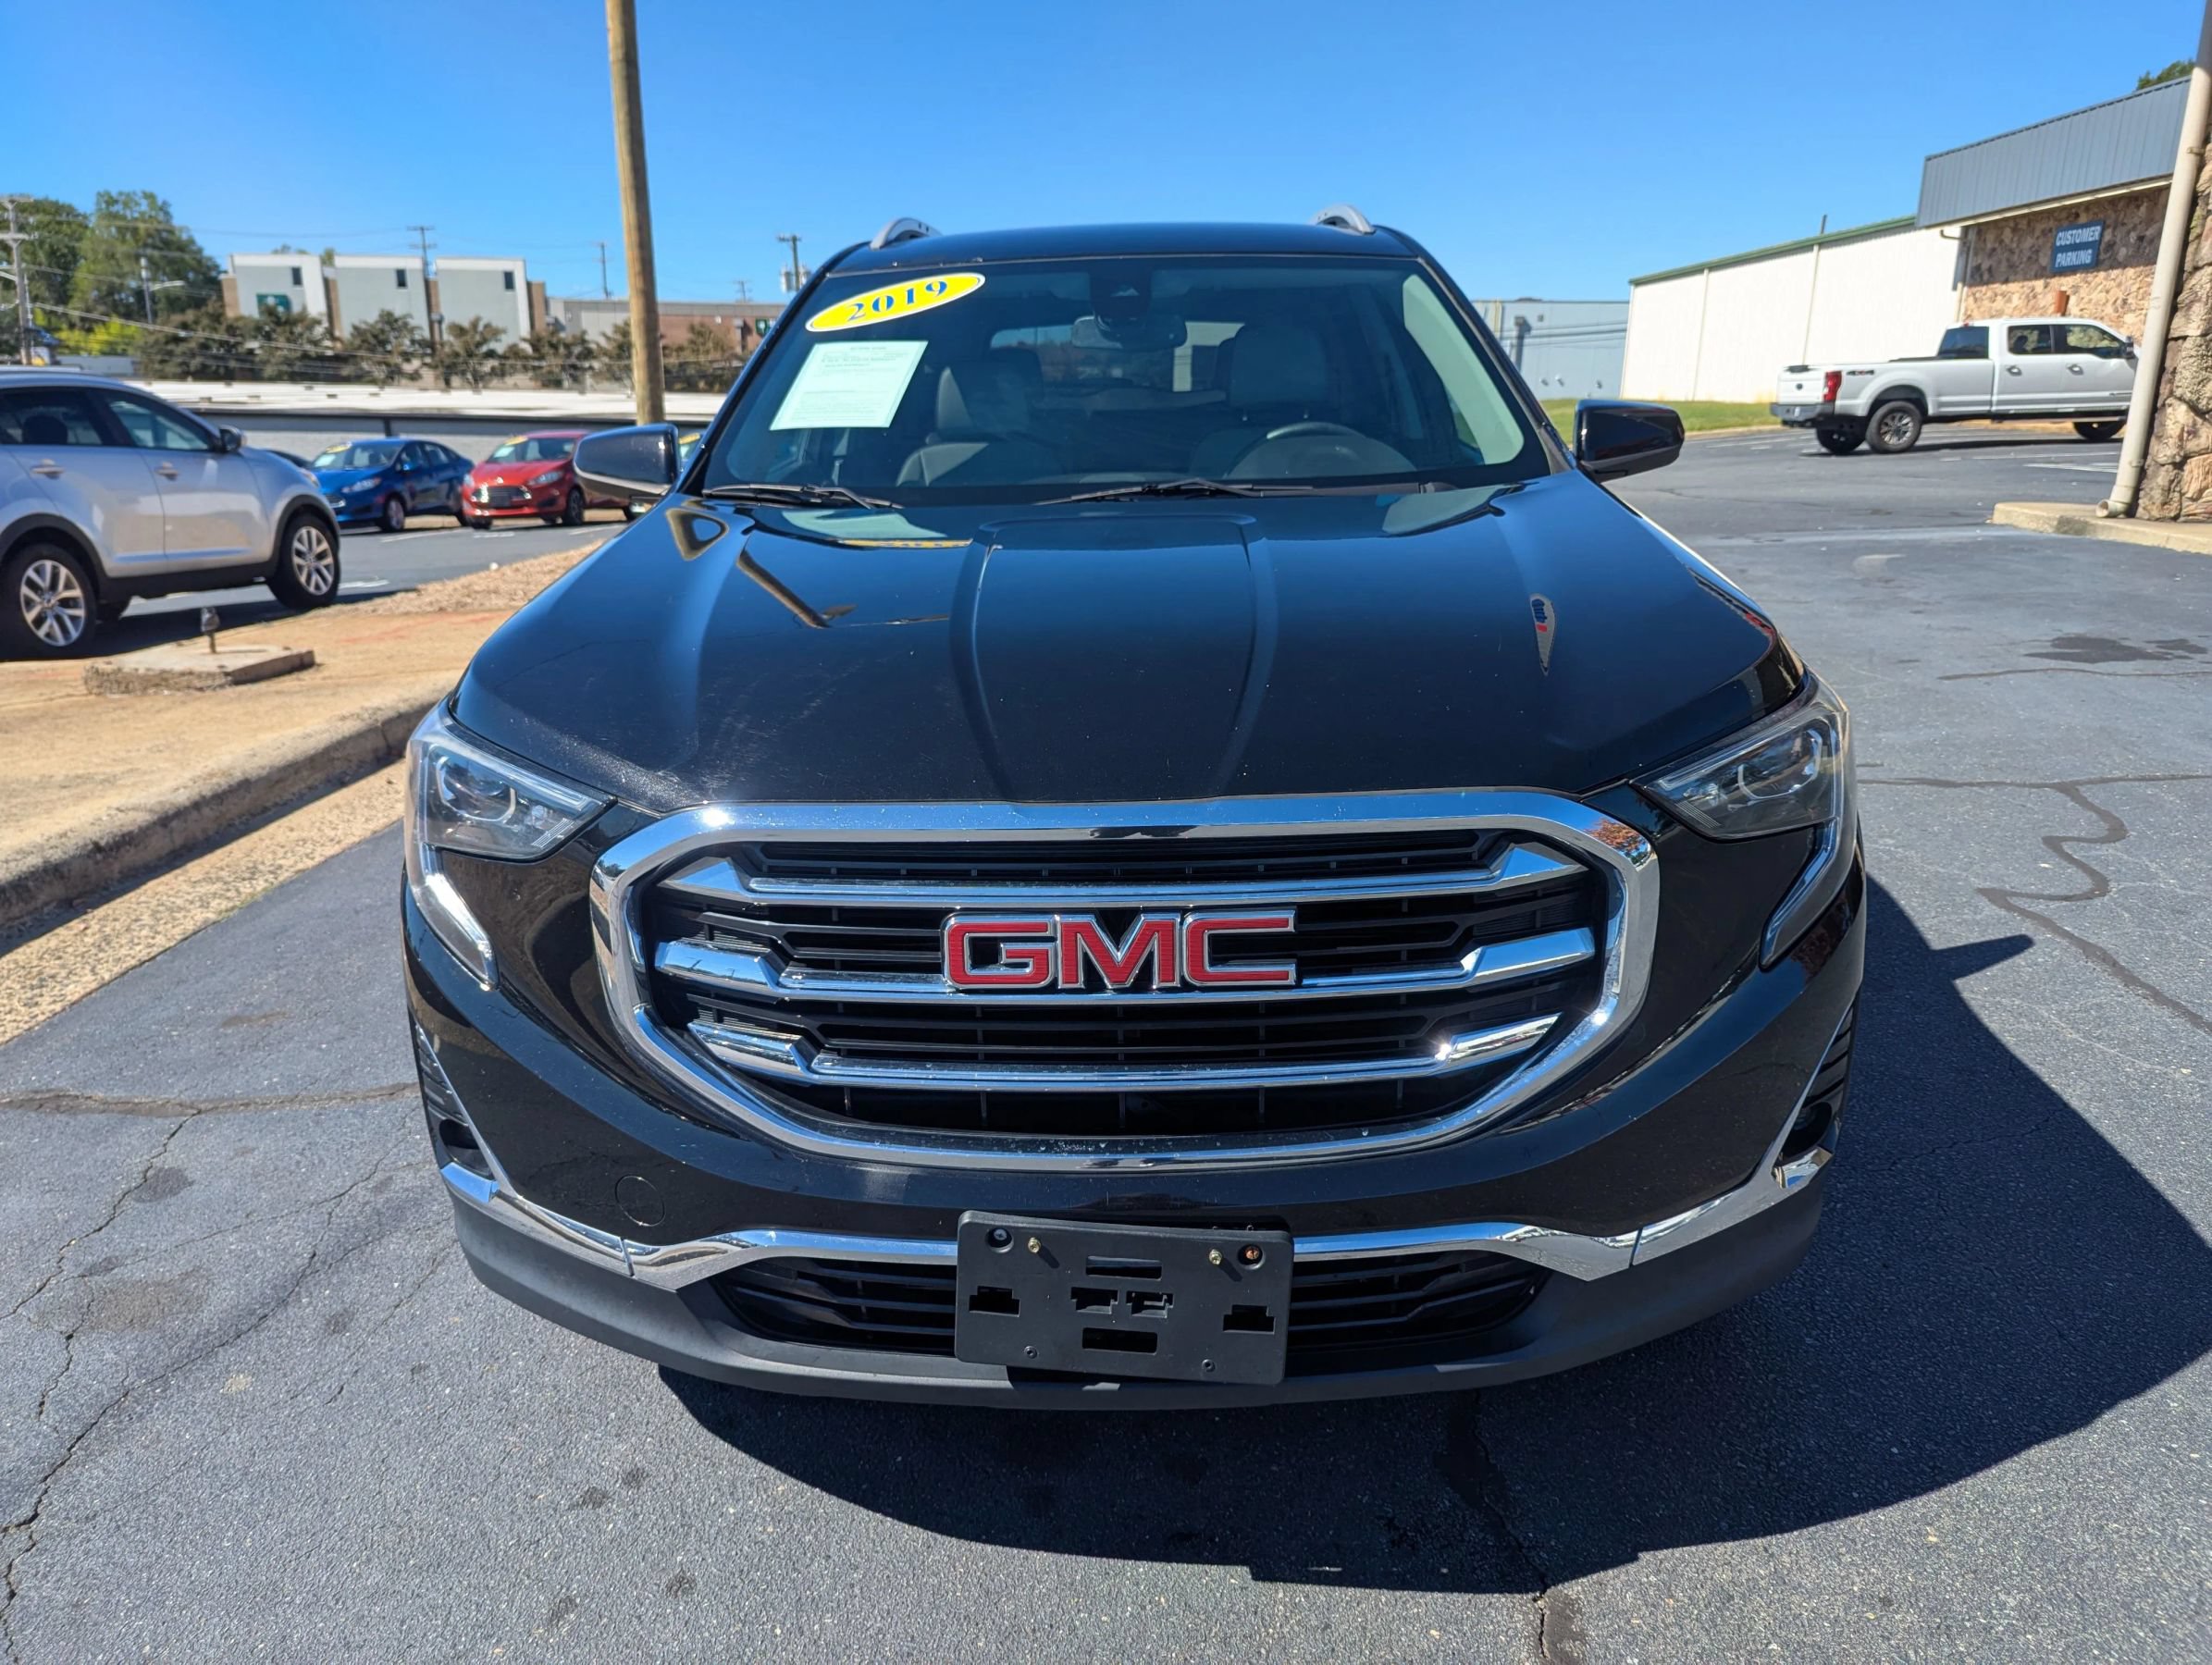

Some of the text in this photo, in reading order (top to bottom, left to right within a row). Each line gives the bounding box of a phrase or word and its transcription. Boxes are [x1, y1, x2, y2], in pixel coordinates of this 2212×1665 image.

[2056, 226, 2101, 246] CUSTOMER
[2055, 249, 2093, 267] PARKING
[846, 280, 948, 321] 2019
[943, 910, 1296, 990] GMC
